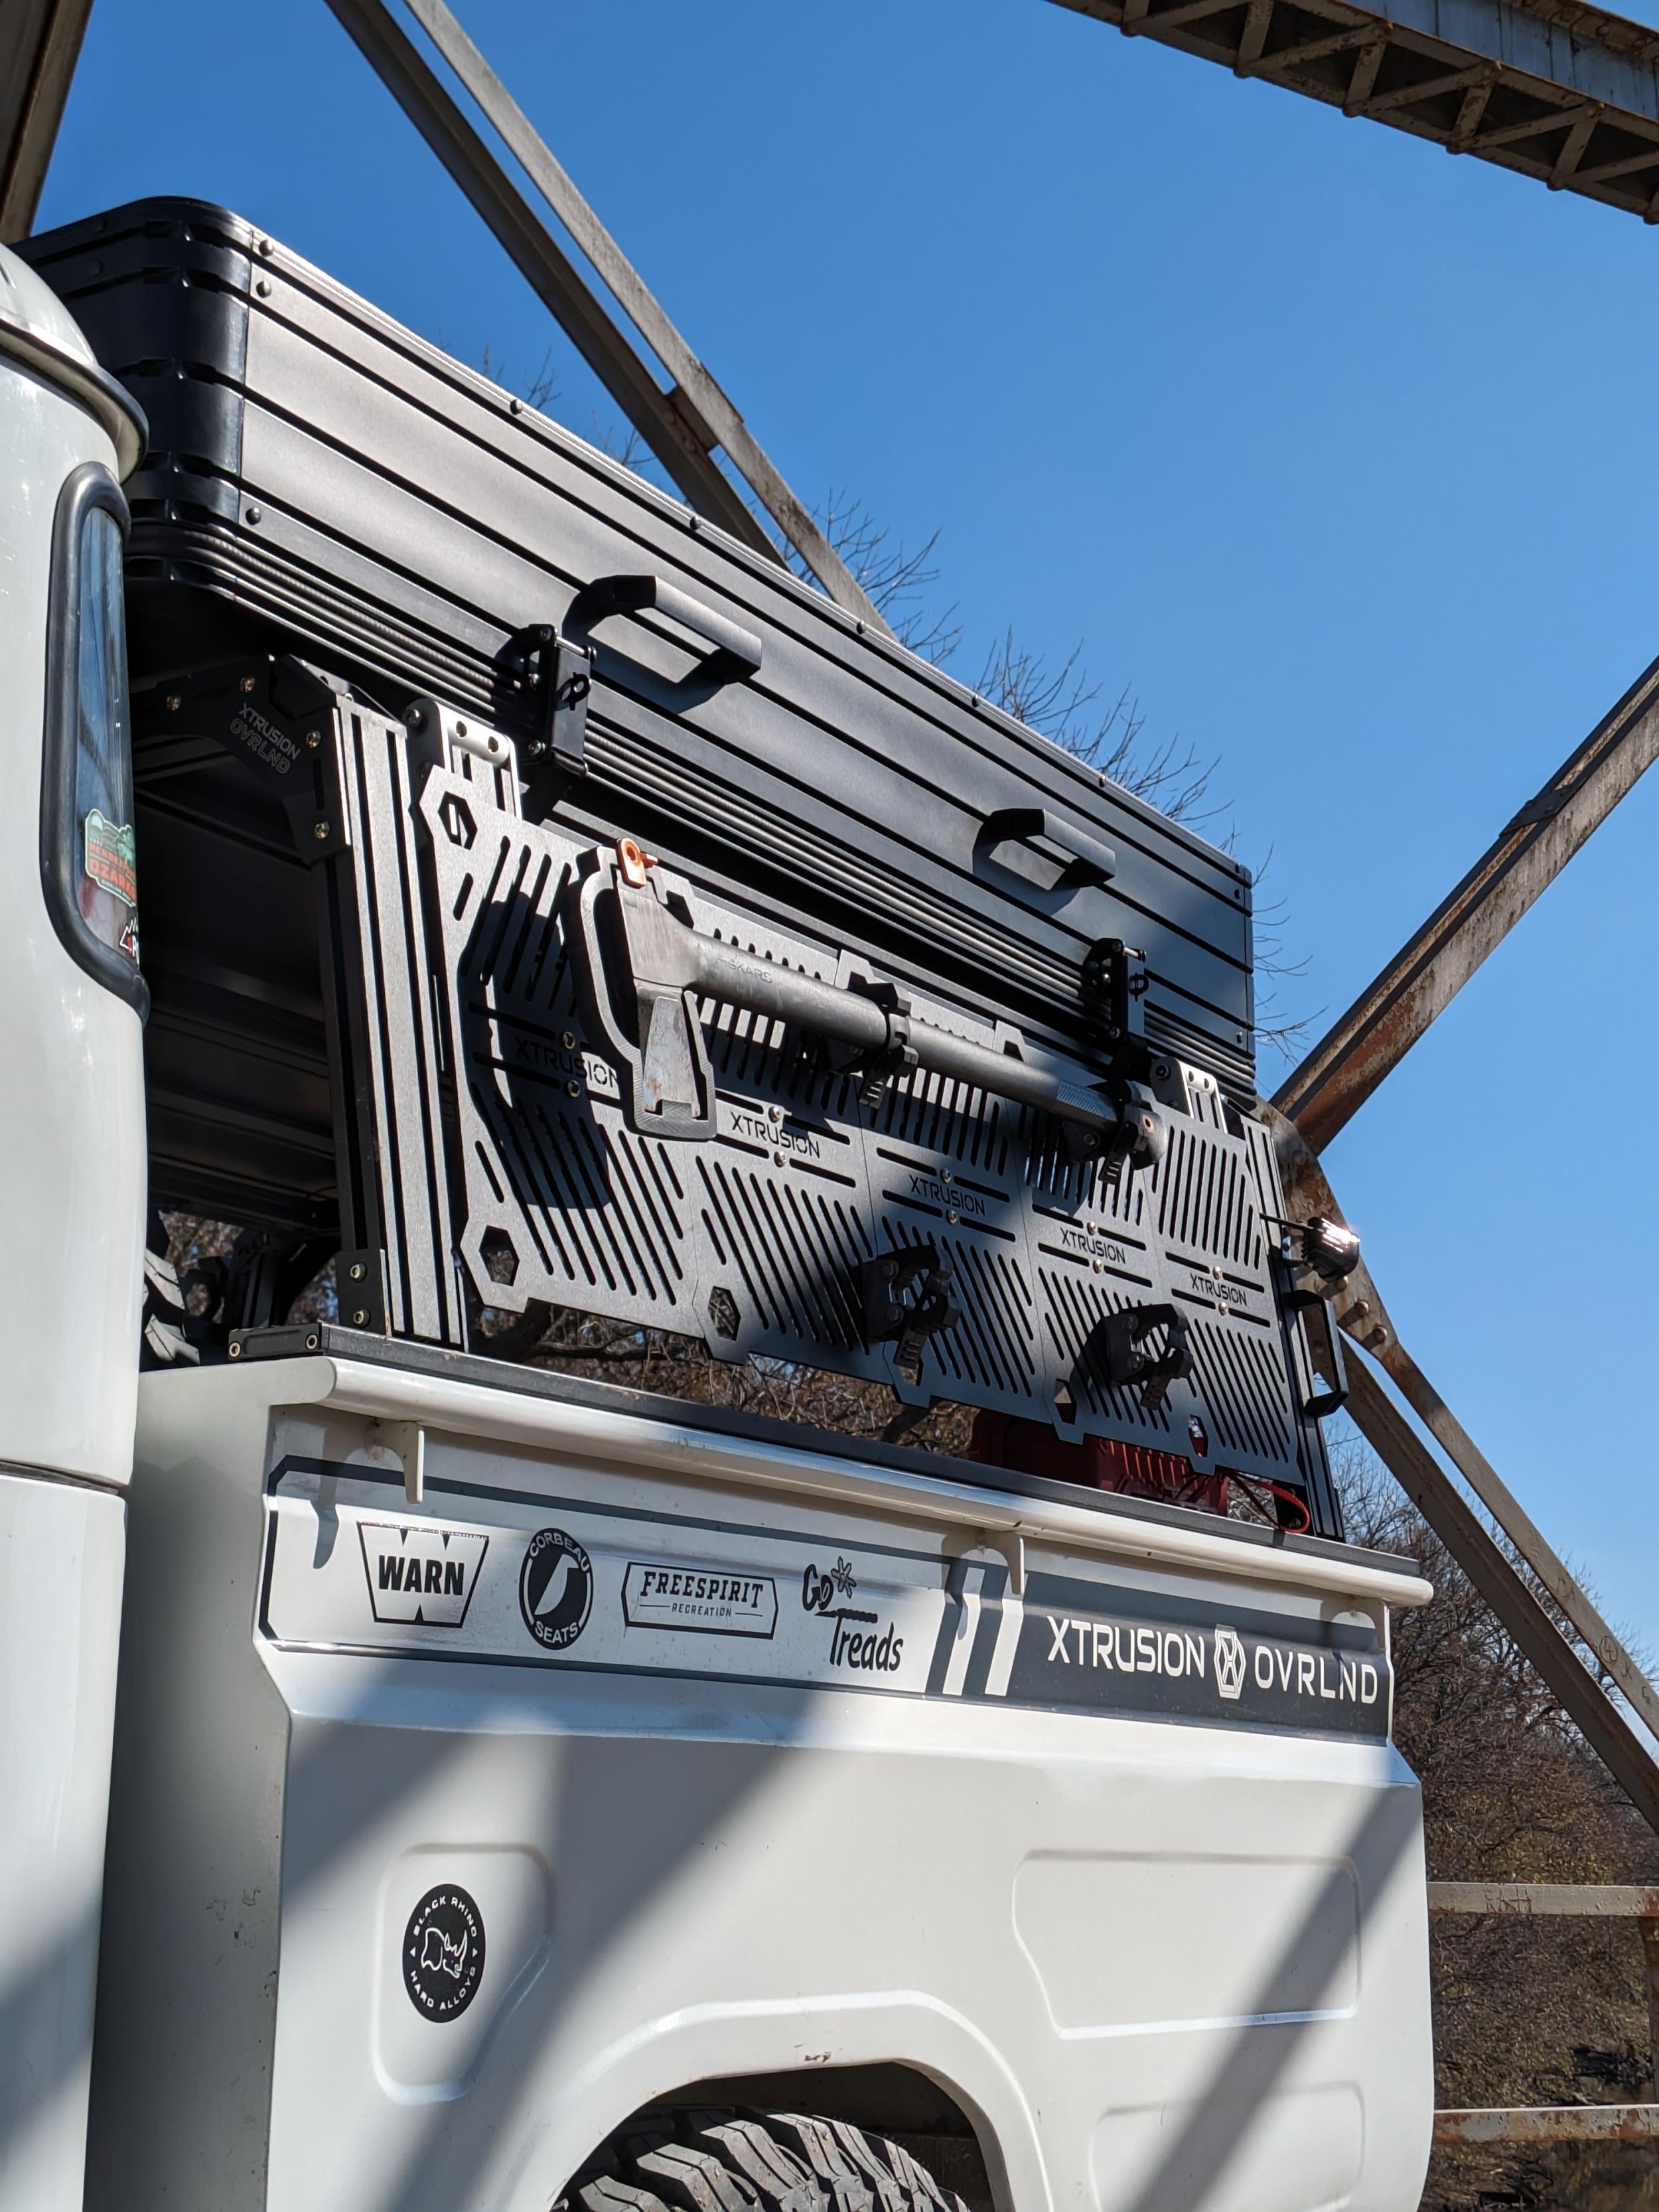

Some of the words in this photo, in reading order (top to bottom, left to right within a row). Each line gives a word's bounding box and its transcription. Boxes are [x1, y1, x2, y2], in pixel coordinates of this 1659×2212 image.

[230, 718, 291, 774] OVRLND
[239, 703, 300, 759] XTRUSION
[731, 1111, 820, 1159] XTRUSION
[909, 1174, 985, 1217] XTRUSION
[1060, 1227, 1126, 1264] XTRUSION
[1190, 1272, 1248, 1306] XTRUSION
[530, 1532, 590, 1572] CORBEAU
[379, 1555, 465, 1595] WARN
[640, 1571, 763, 1608] FREESPIRIT
[672, 1603, 732, 1617] RECREATION
[534, 1621, 578, 1643] SEATS
[814, 1608, 904, 1671] Treads
[1046, 1615, 1205, 1678] XTRUSION
[1255, 1645, 1378, 1704] OVRLND
[413, 1895, 446, 1937] BLACK
[451, 1897, 477, 1937] RHINO
[411, 1970, 434, 2008] HARD
[439, 1966, 476, 2010] ALLOYS
